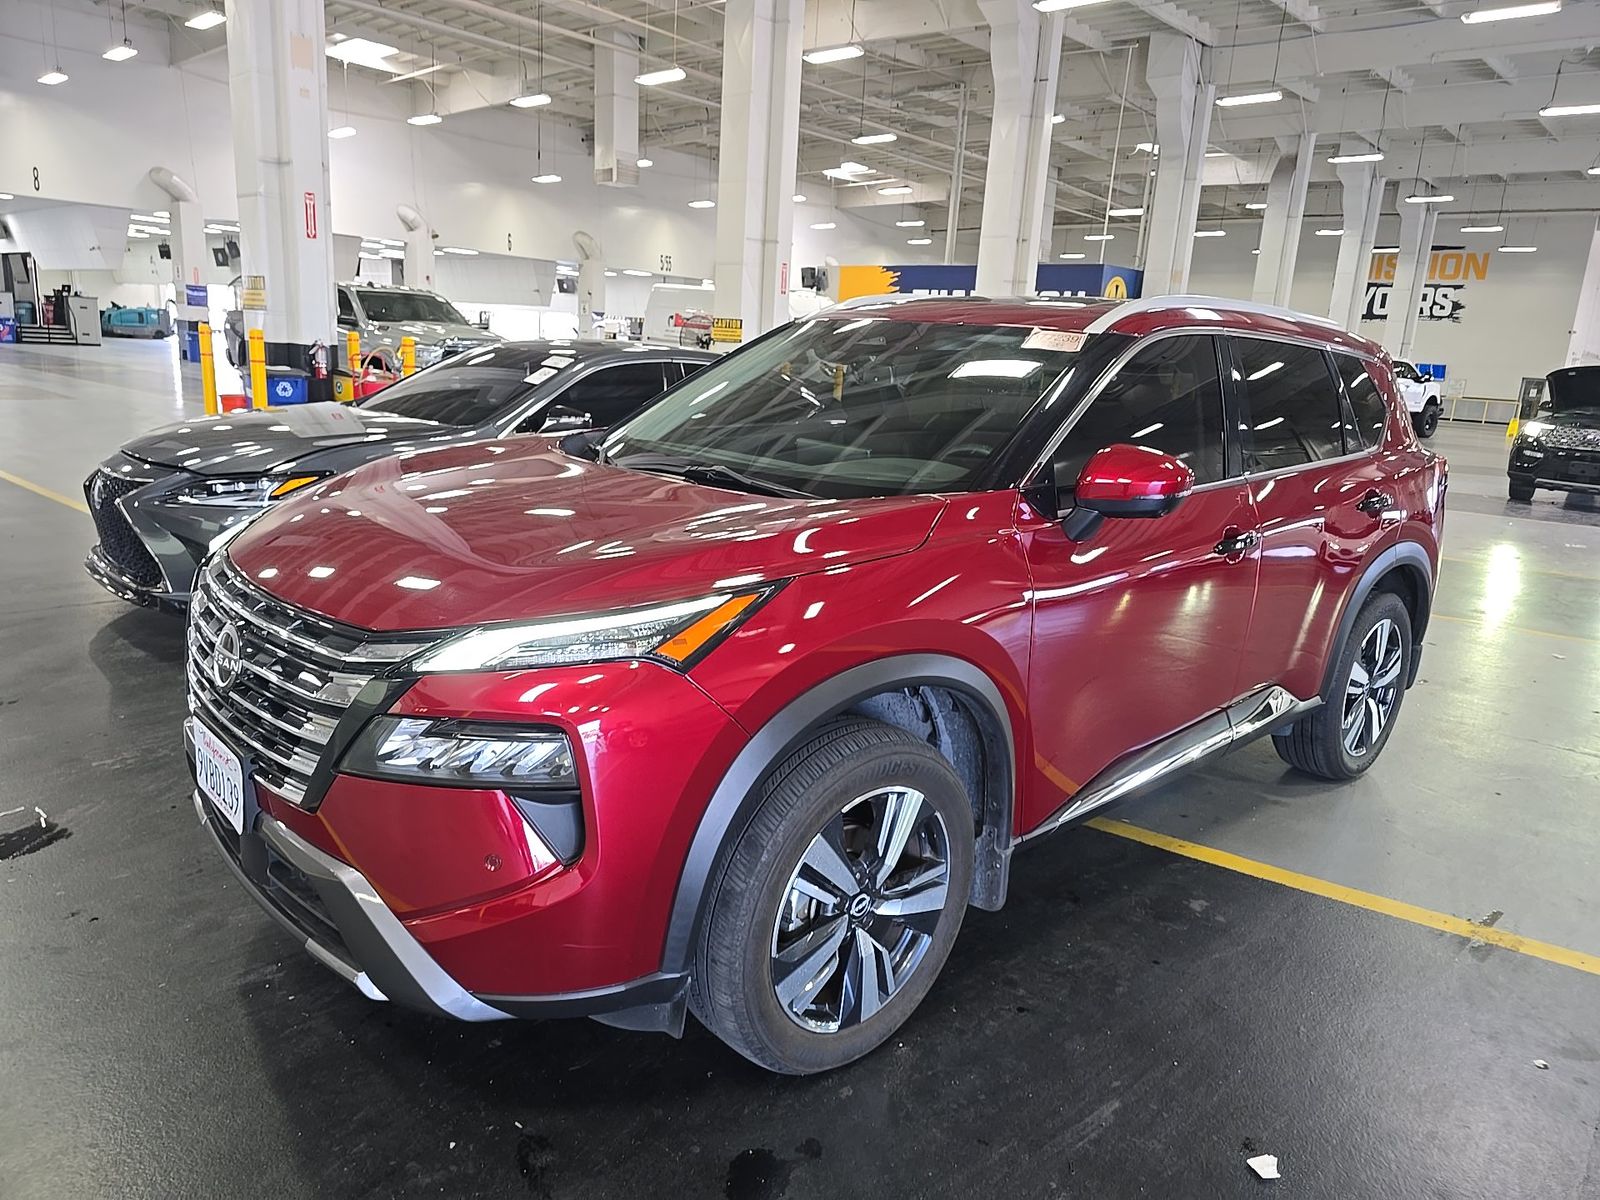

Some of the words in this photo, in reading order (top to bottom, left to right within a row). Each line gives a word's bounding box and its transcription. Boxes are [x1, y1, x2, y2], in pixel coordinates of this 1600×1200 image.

[33, 166, 40, 191] 8
[507, 233, 512, 251] 6
[1368, 252, 1489, 281] ISION
[1361, 287, 1455, 317] YORS
[713, 318, 742, 328] CAUTION
